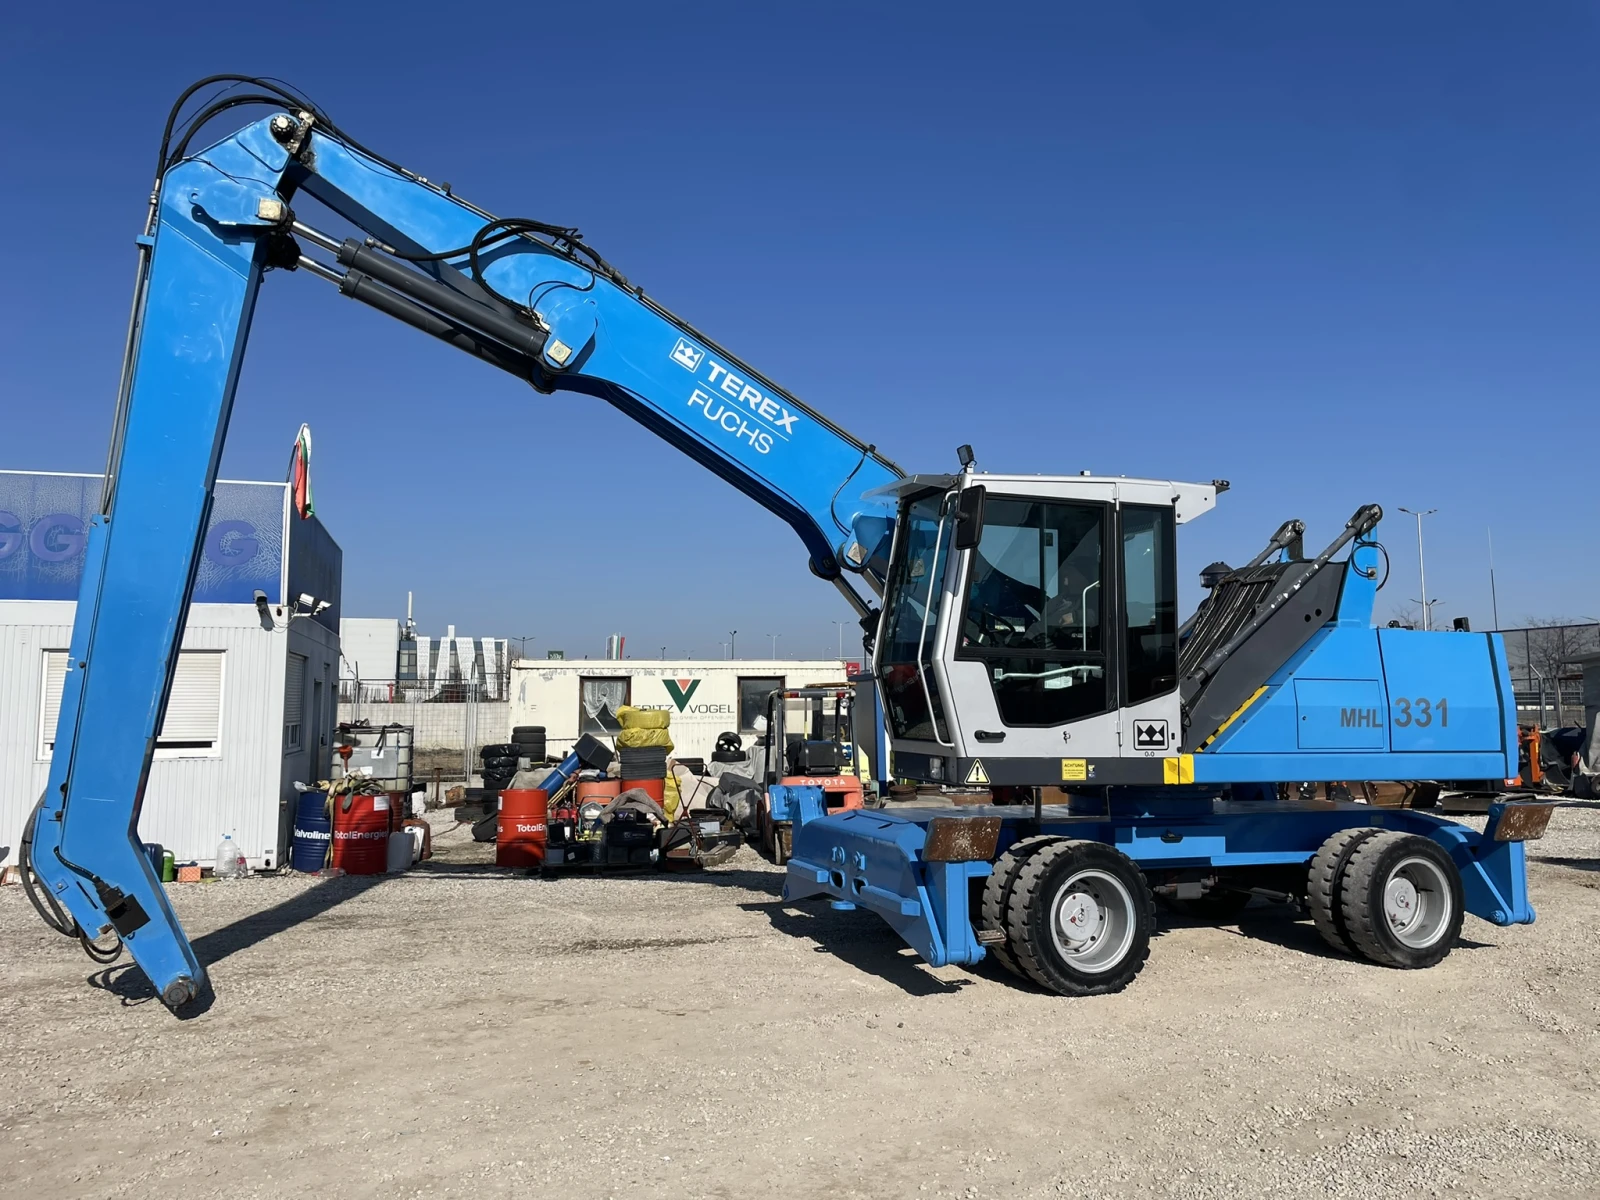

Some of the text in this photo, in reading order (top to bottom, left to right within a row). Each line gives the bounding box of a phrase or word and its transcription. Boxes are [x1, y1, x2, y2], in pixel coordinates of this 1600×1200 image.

[708, 360, 799, 435] TEREX
[687, 388, 774, 454] FUCHS
[689, 704, 735, 714] VOGEL
[1340, 697, 1448, 728] MHL 331
[293, 825, 331, 840] Valvoline
[516, 823, 546, 832] TotalEn
